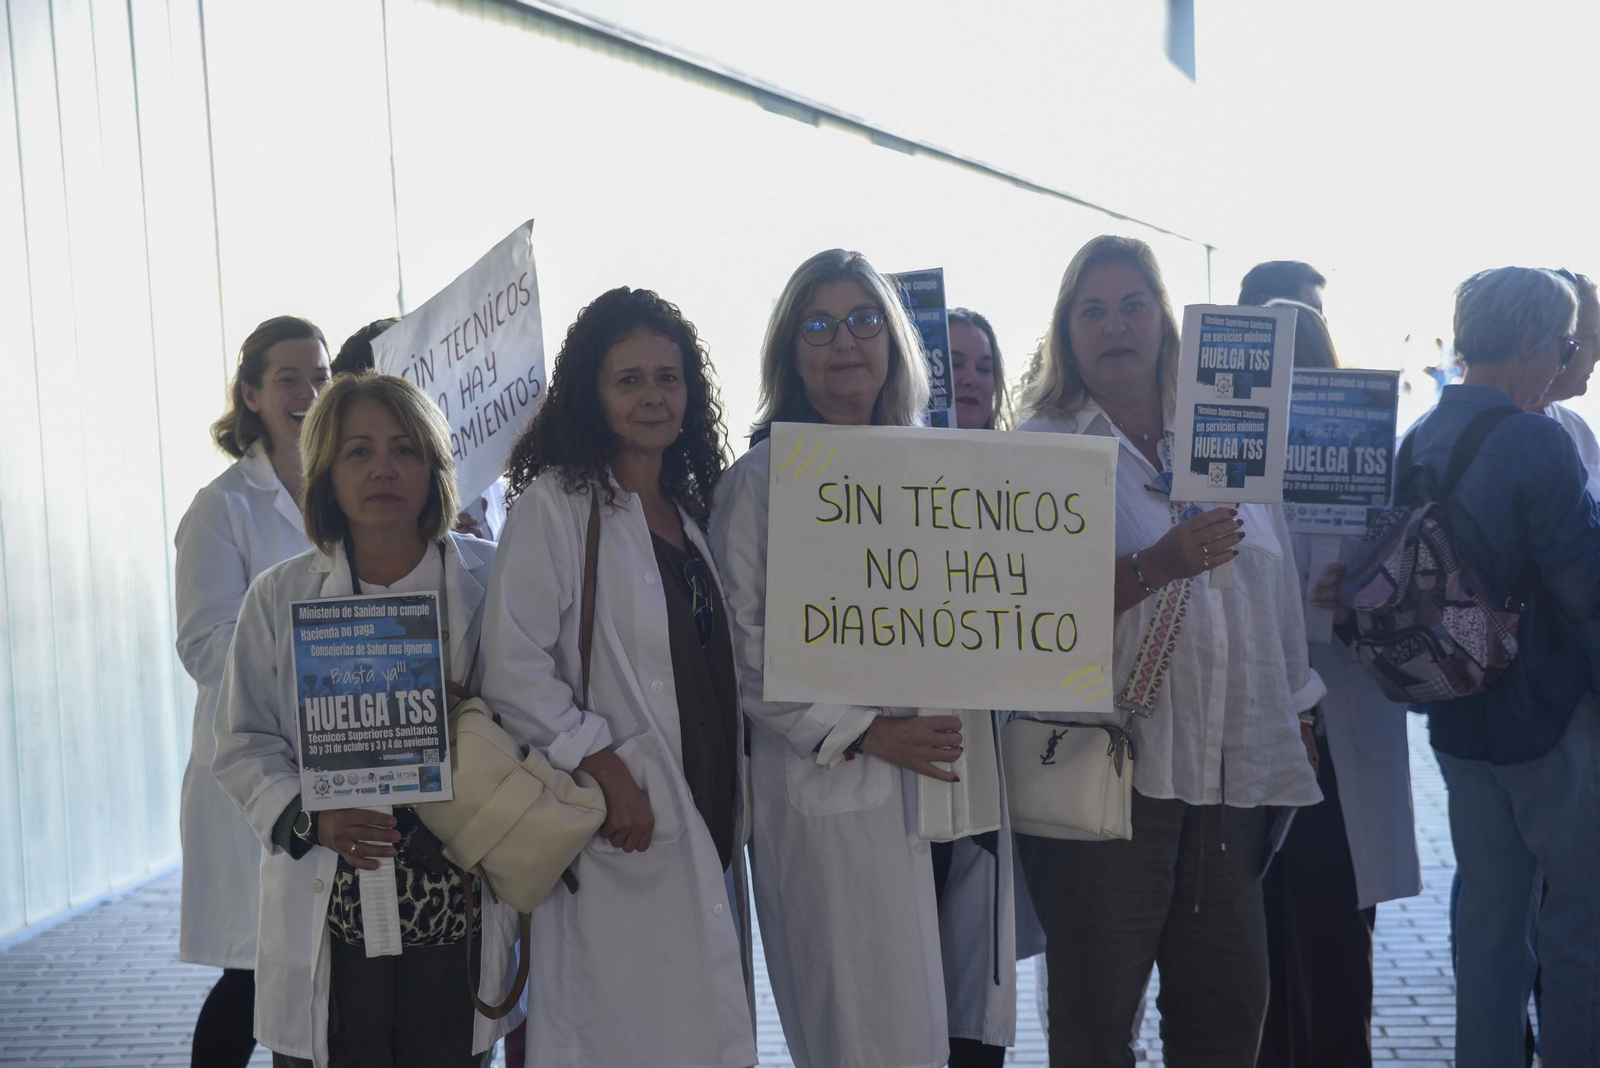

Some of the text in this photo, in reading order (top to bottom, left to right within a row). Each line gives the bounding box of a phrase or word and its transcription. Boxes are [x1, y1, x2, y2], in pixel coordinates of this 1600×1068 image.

[440, 271, 531, 369] TÉCNICOS
[1225, 318, 1250, 328] Superiores
[1250, 320, 1273, 331] Sanitarios
[1203, 331, 1272, 343] en servicios mínimos
[1200, 346, 1270, 371] HUELGA TSS
[459, 351, 498, 410] HAY
[450, 365, 541, 461] AMIENTOS
[1197, 405, 1265, 420] Técnicos Superiores Sanitarios
[1196, 420, 1264, 432] en servicios mínimos
[1194, 436, 1264, 460] HUELGA TSS
[1285, 444, 1387, 475] HUELGA TSS
[816, 475, 1086, 534] SIN TÉCNICOS
[866, 547, 1027, 595] NO HAY
[299, 603, 430, 620] Ministerio de Sanidad no cumple
[301, 624, 375, 641] Hacienda no paga
[804, 596, 1078, 653] DIAGNÓSTICO
[311, 641, 433, 657] Consejerías de Salud nos ignoran
[330, 665, 374, 686] Basta
[305, 688, 438, 732] HUELGA TSS
[308, 724, 438, 744] Técnicos Superiores Sanitarios
[309, 736, 439, 756] 30 y 31 de octubre y 3 y 4 de noviembre
